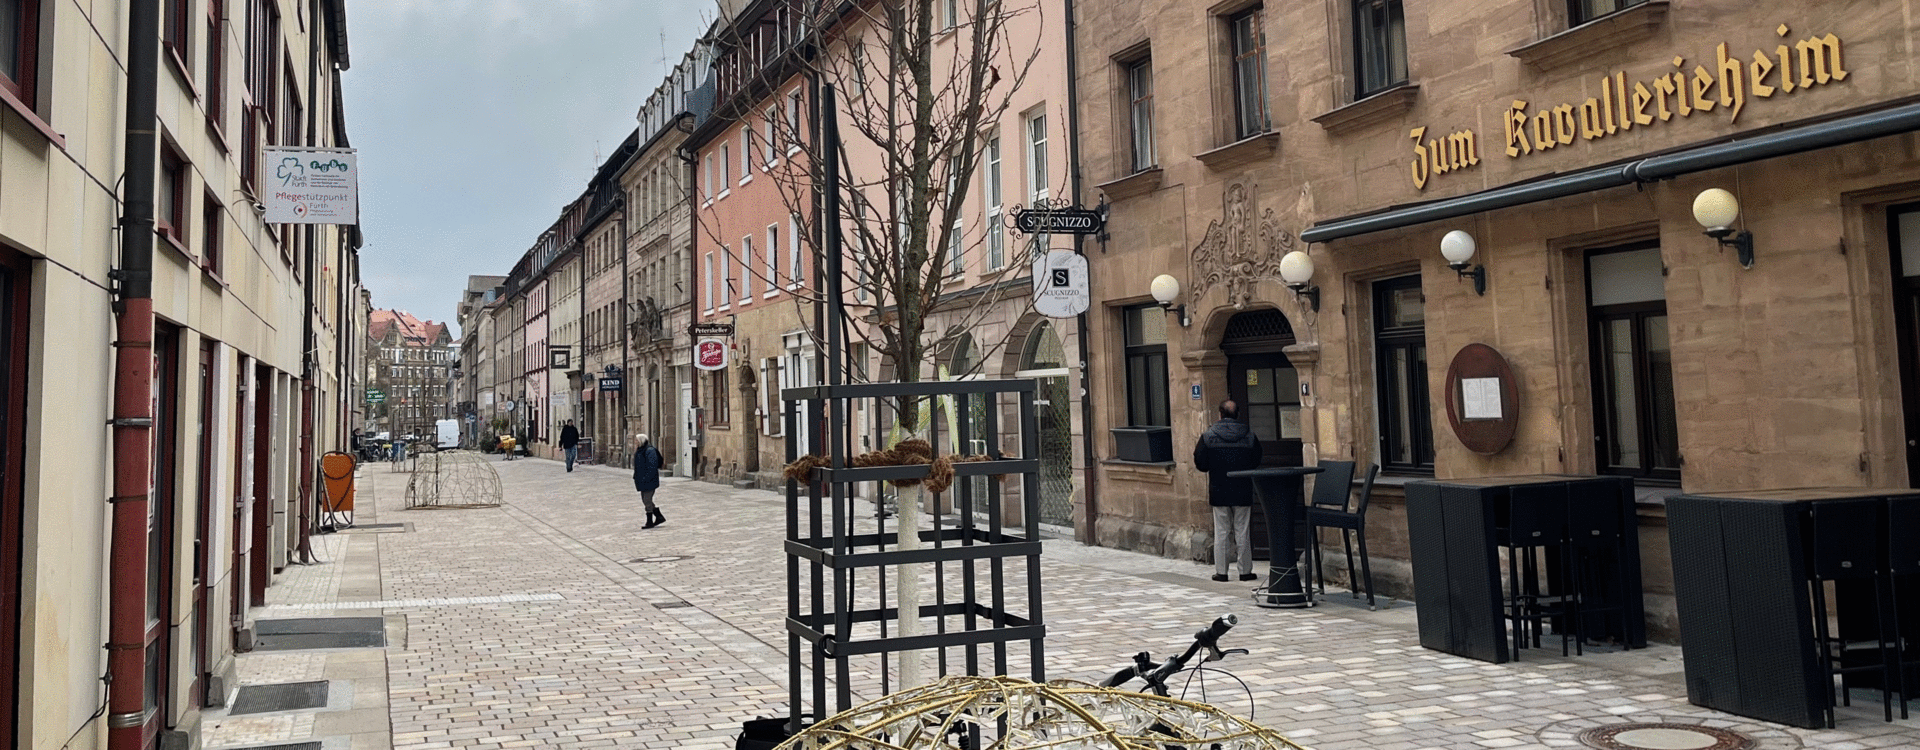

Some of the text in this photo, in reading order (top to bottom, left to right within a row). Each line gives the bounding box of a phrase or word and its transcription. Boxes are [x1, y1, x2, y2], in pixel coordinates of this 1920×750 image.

[1409, 23, 1849, 191] Zum Kavallerieheim
[1055, 271, 1067, 285] S
